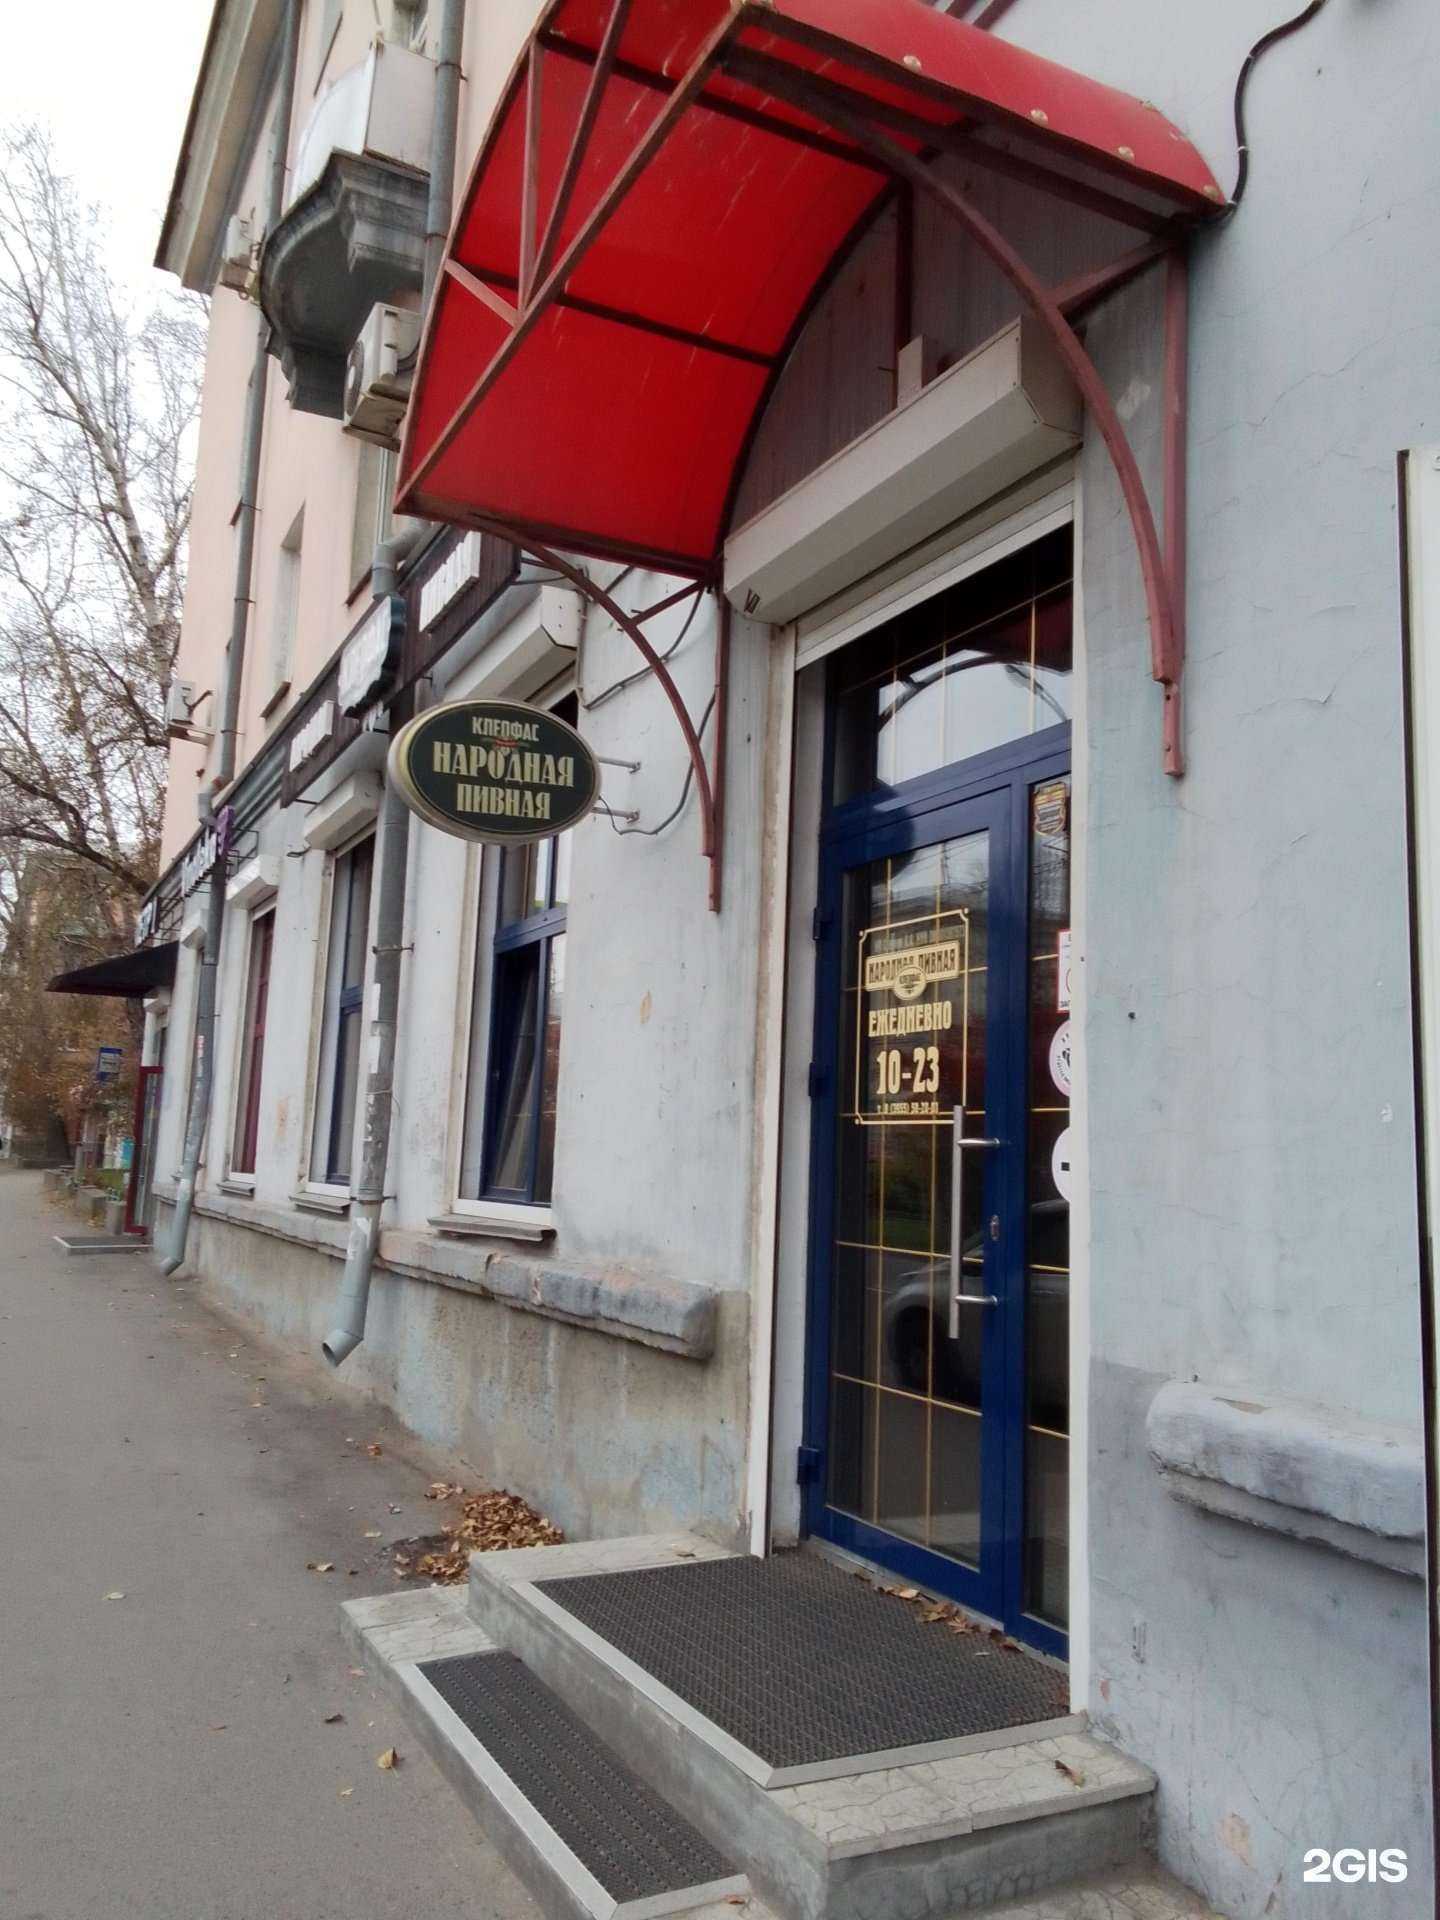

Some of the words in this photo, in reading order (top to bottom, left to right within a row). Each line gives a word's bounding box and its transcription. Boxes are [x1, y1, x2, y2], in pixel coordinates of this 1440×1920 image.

[472, 716, 539, 742] КЛЕПФАС
[433, 741, 574, 787] НАРОДНАЯ
[456, 783, 550, 819] ПИВНАЯ
[918, 948, 956, 974] ПИВНАЯ
[868, 1000, 952, 1038] ЕЖЕДНЕВНО
[876, 1046, 940, 1095] 10-23
